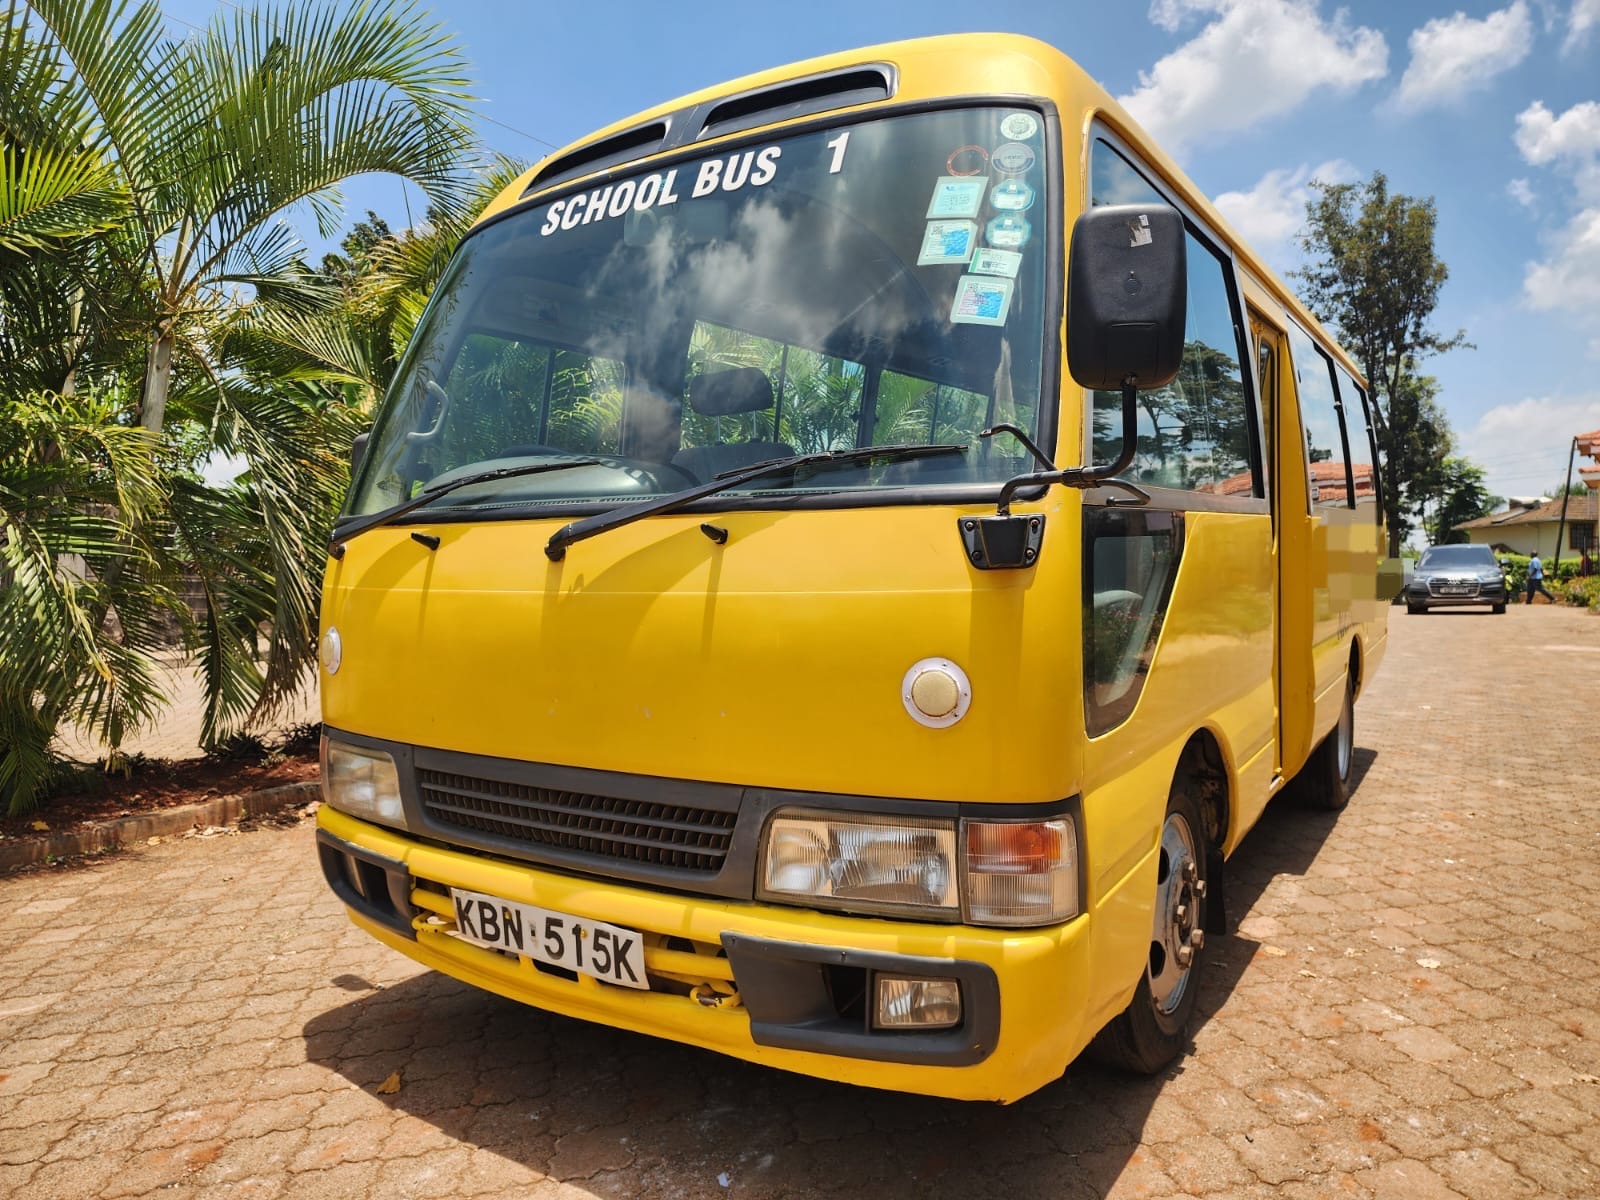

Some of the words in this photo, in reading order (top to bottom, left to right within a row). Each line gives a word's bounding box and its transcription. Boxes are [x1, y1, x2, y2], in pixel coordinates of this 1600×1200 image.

[540, 169, 678, 236] SCHOOL
[691, 146, 782, 198] BUS
[827, 132, 850, 174] 1
[455, 896, 524, 950] KBN
[544, 917, 639, 982] 515K
